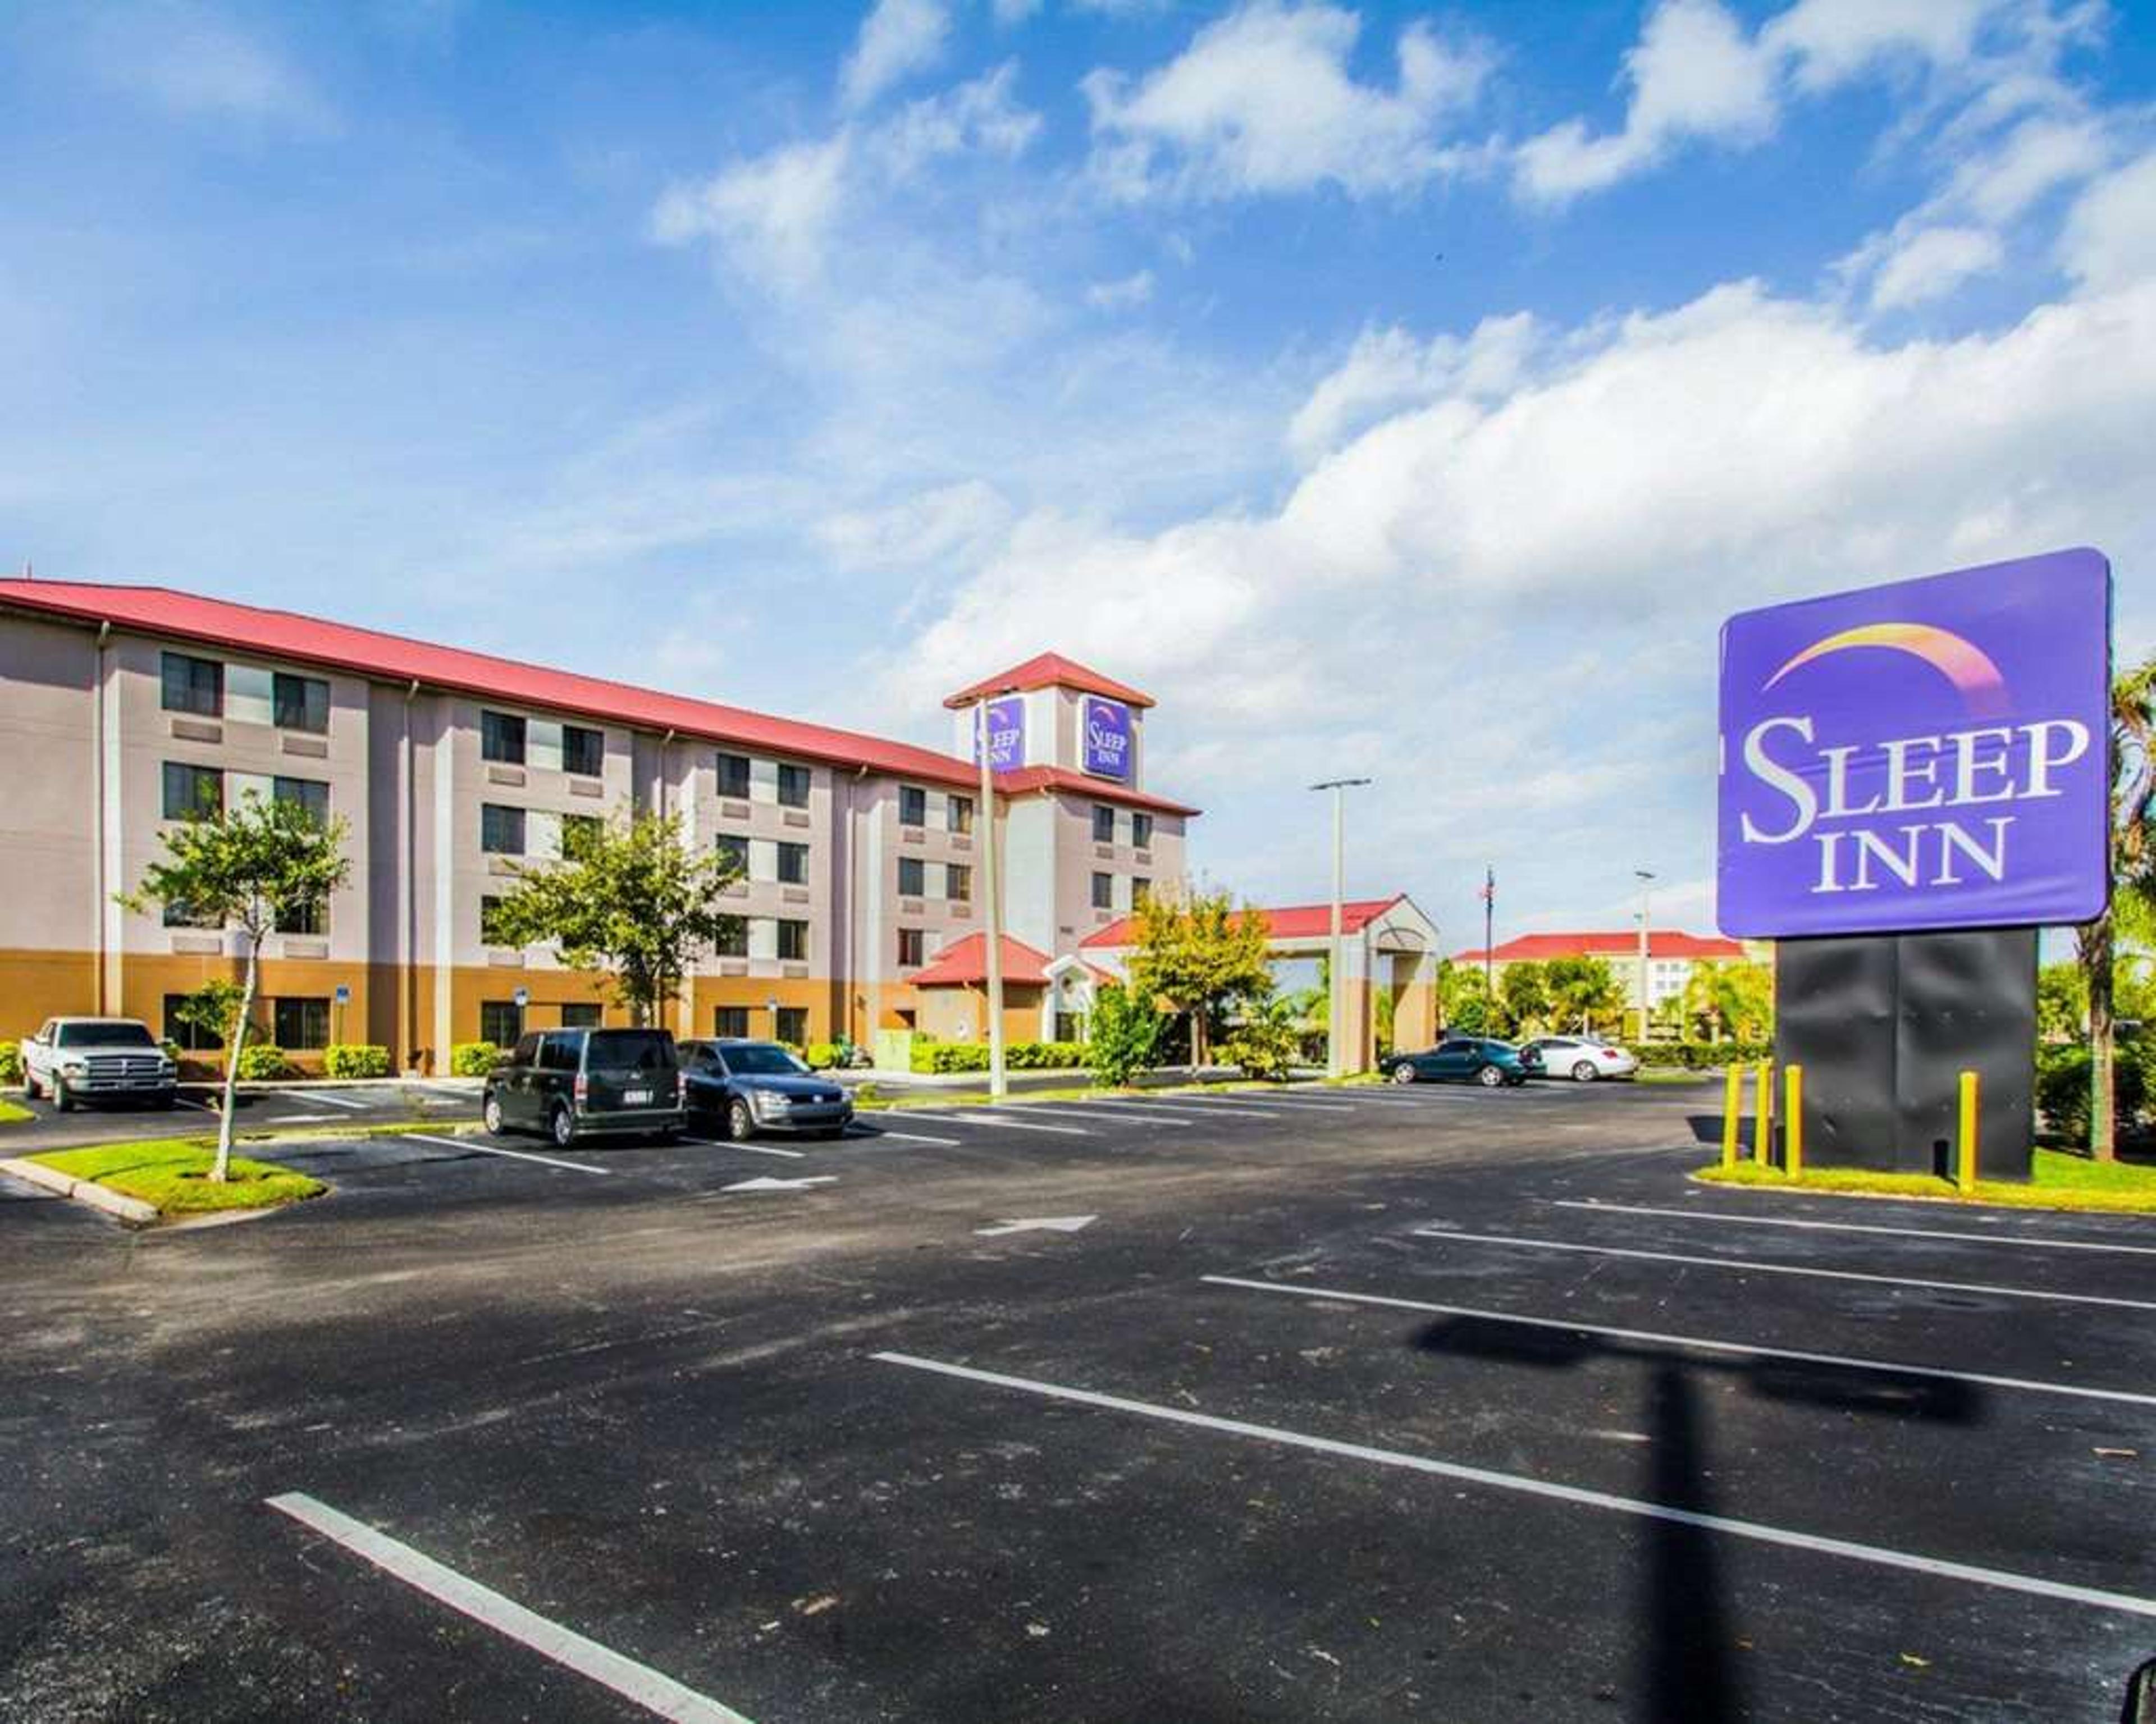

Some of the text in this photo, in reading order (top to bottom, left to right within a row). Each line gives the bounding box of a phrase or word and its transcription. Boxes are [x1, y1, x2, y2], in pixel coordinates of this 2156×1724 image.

[1090, 721, 1126, 752] SLEEP
[1098, 749, 1120, 766] INN
[1741, 716, 2090, 844] SLEEP
[1811, 816, 2016, 893] INN
